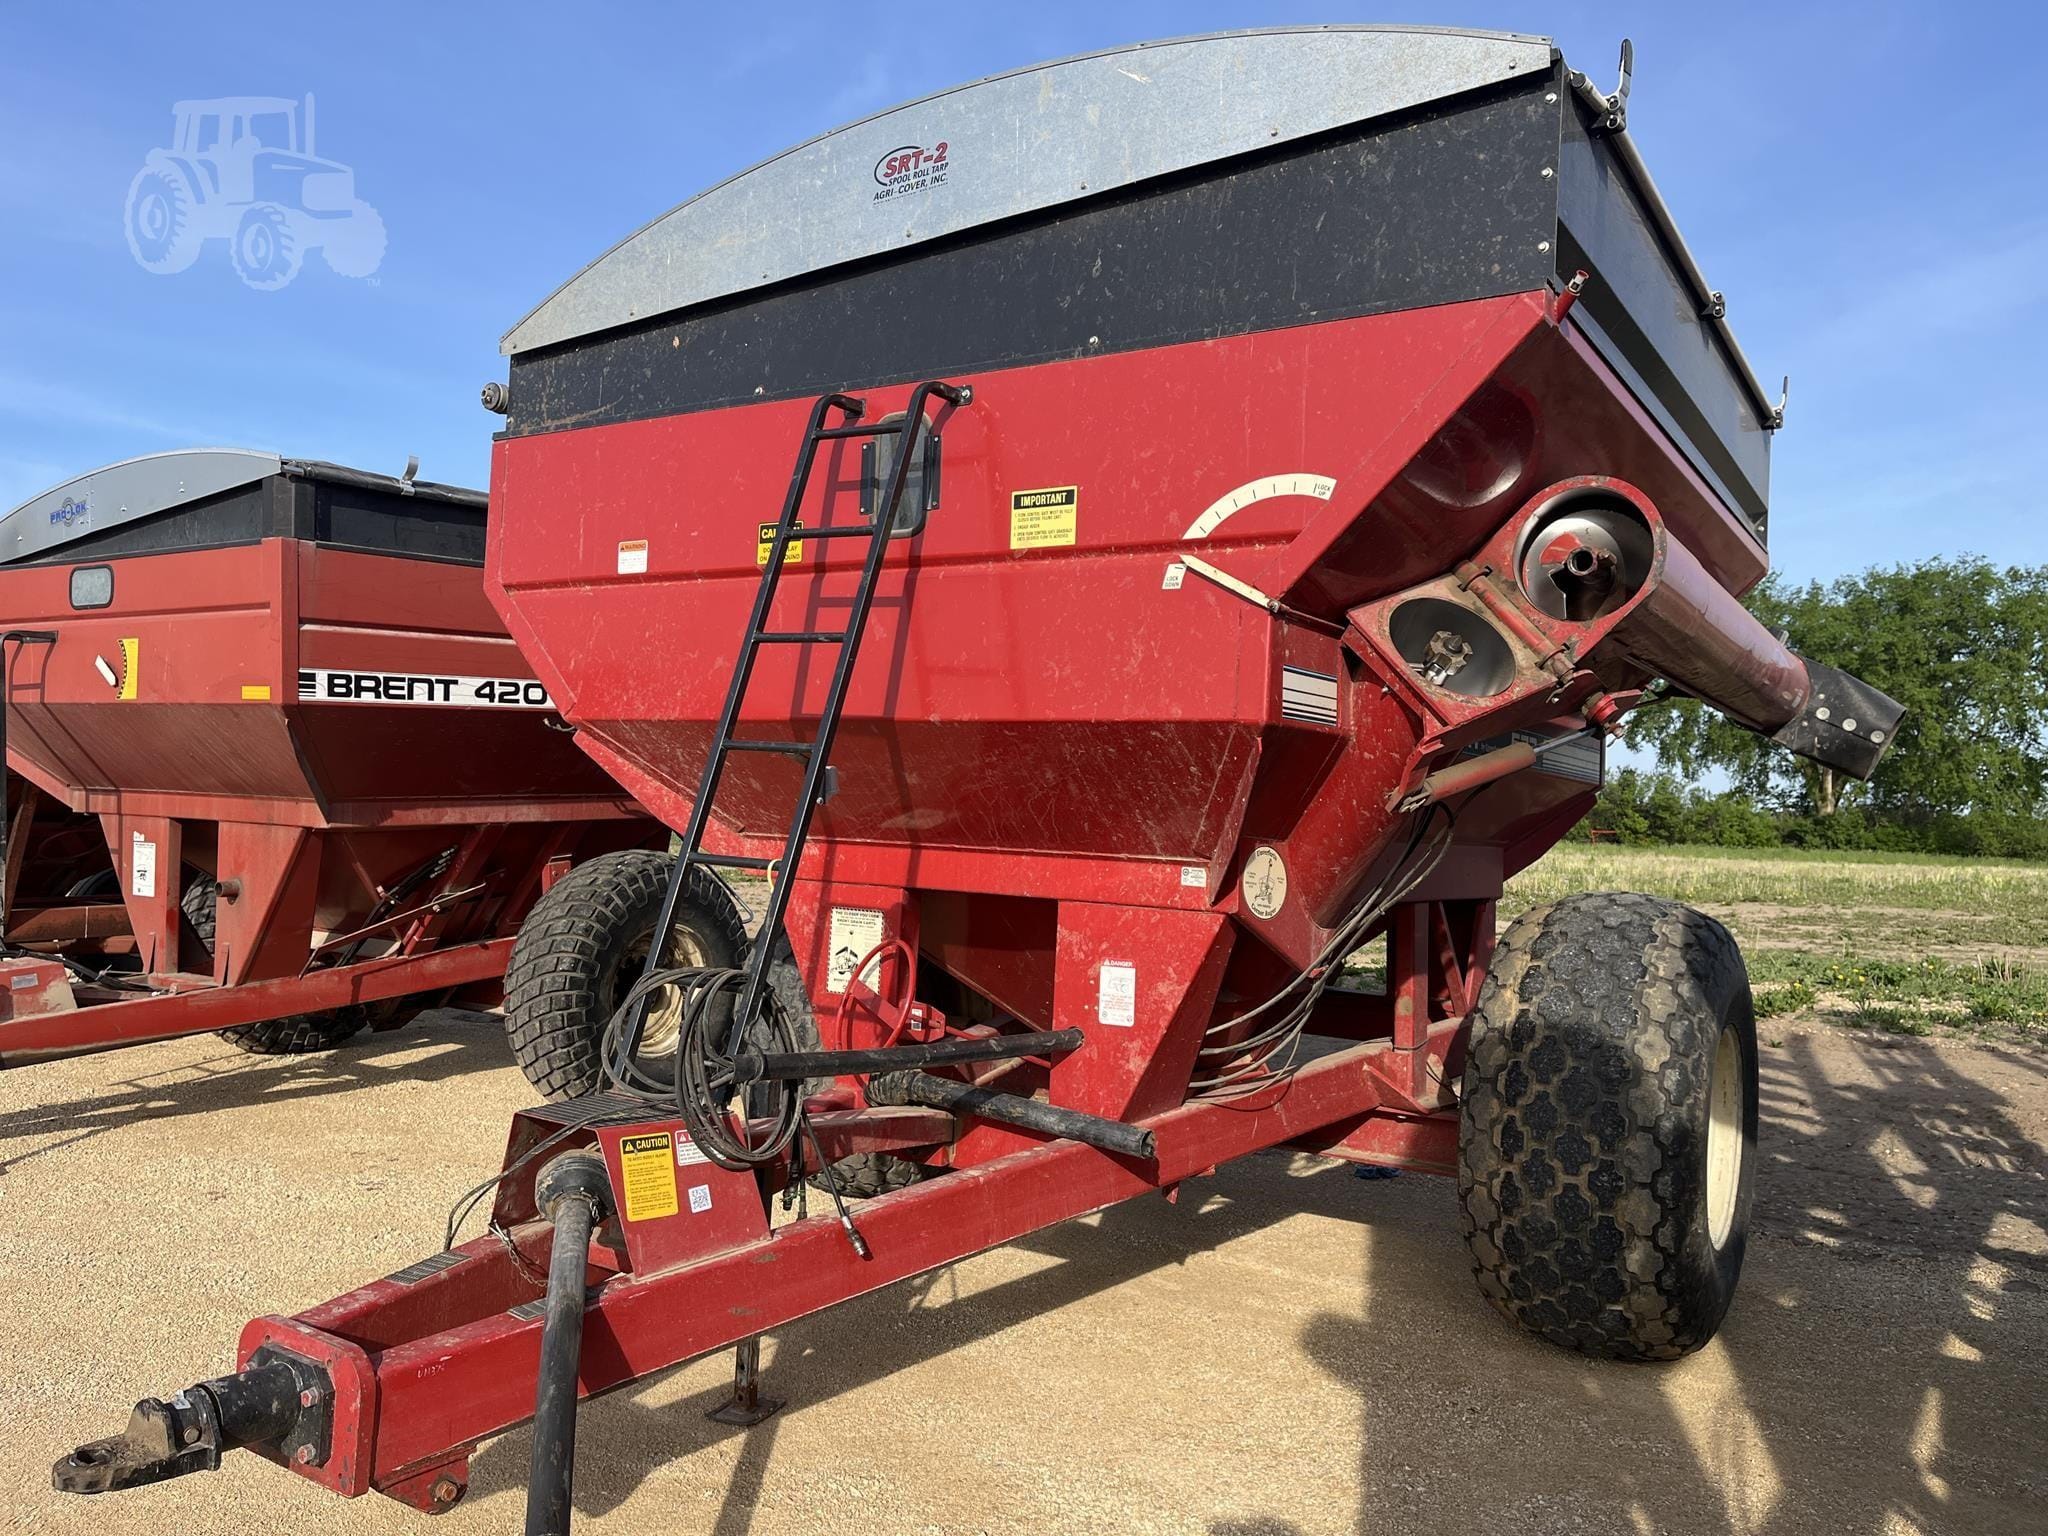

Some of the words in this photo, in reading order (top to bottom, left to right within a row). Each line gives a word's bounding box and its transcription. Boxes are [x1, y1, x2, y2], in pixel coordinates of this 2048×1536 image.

[883, 142, 948, 178] SRT-2
[888, 173, 911, 186] SPOOL
[912, 168, 930, 179] ROLL
[932, 162, 948, 174] TARP
[930, 173, 948, 186] INC.
[1020, 492, 1068, 506] IMPORTANT
[327, 673, 458, 702] BRENT
[474, 681, 548, 704] 420
[636, 1137, 668, 1149] CAUTION
